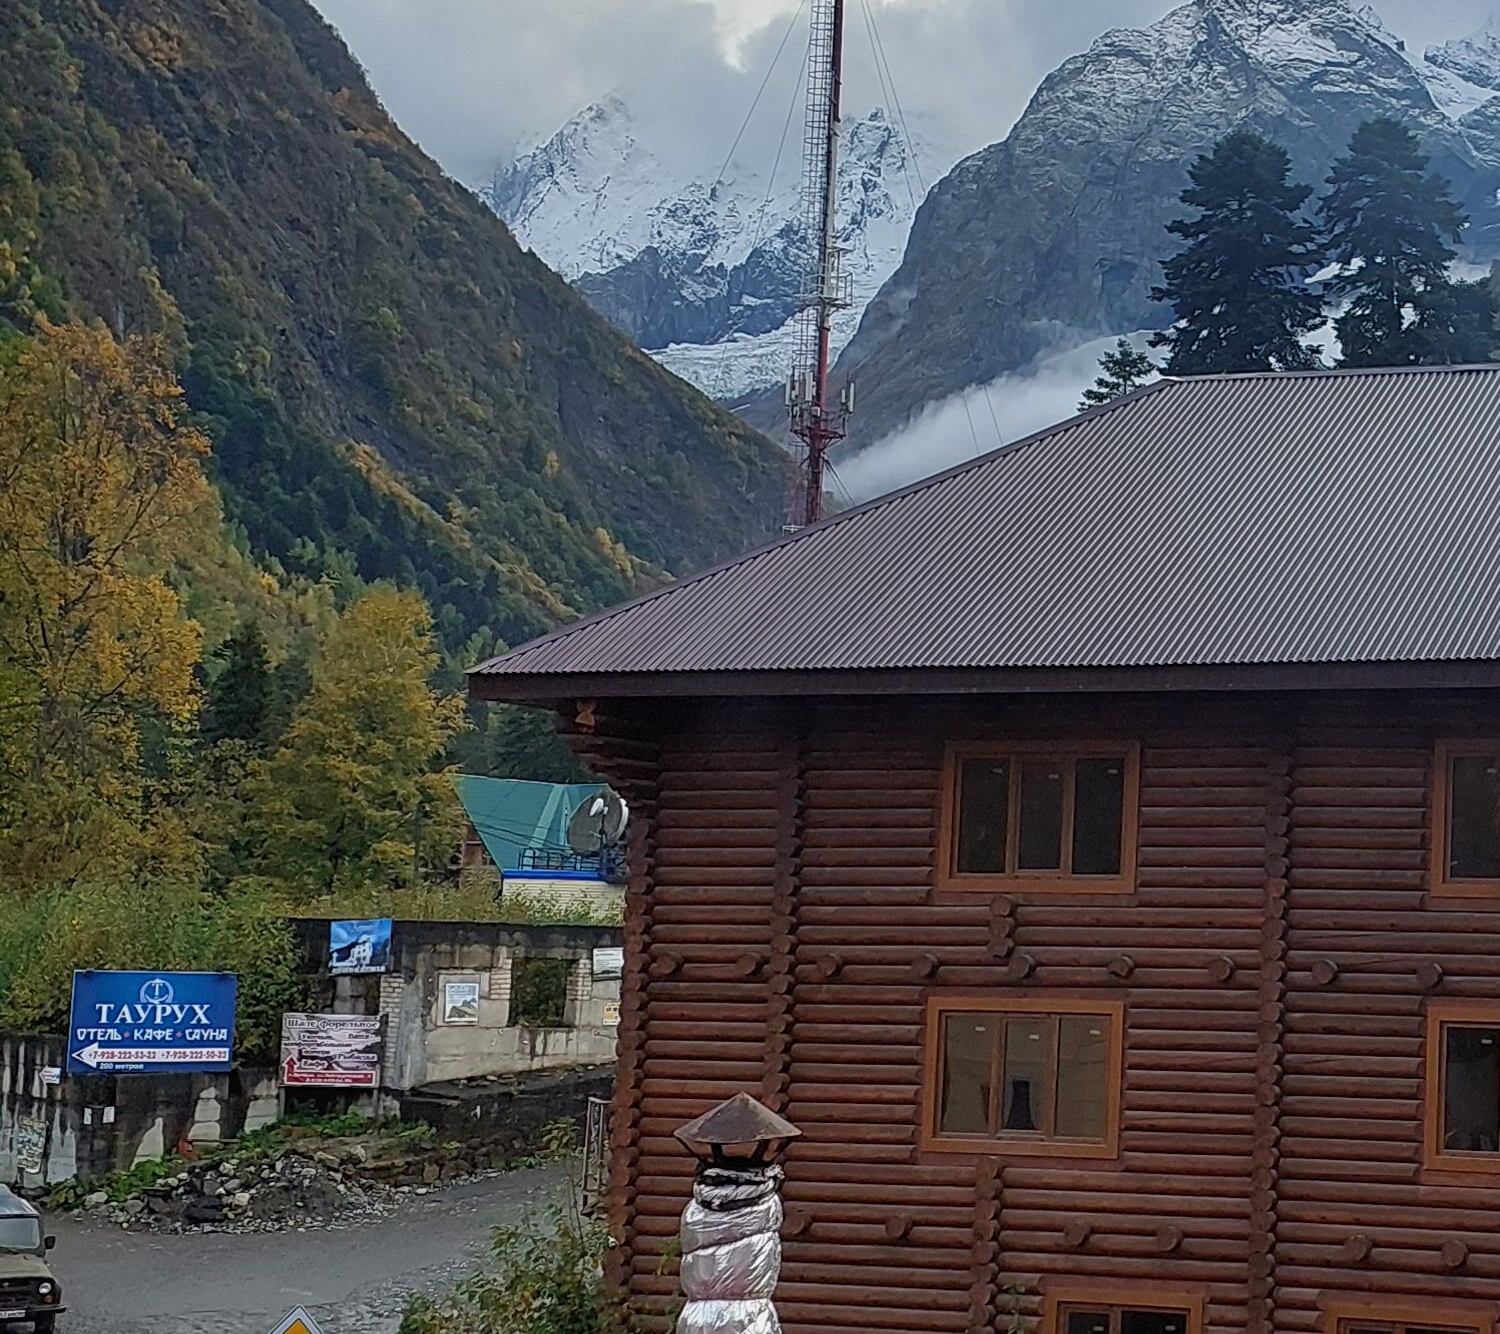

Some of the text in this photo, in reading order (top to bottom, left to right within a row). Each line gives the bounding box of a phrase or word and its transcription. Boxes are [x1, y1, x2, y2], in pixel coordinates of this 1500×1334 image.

[96, 1003, 210, 1024] ТАУРУХ
[77, 1028, 228, 1040] ОТЕЛЬ КАФЕ САУНА
[100, 1062, 114, 1070] 200
